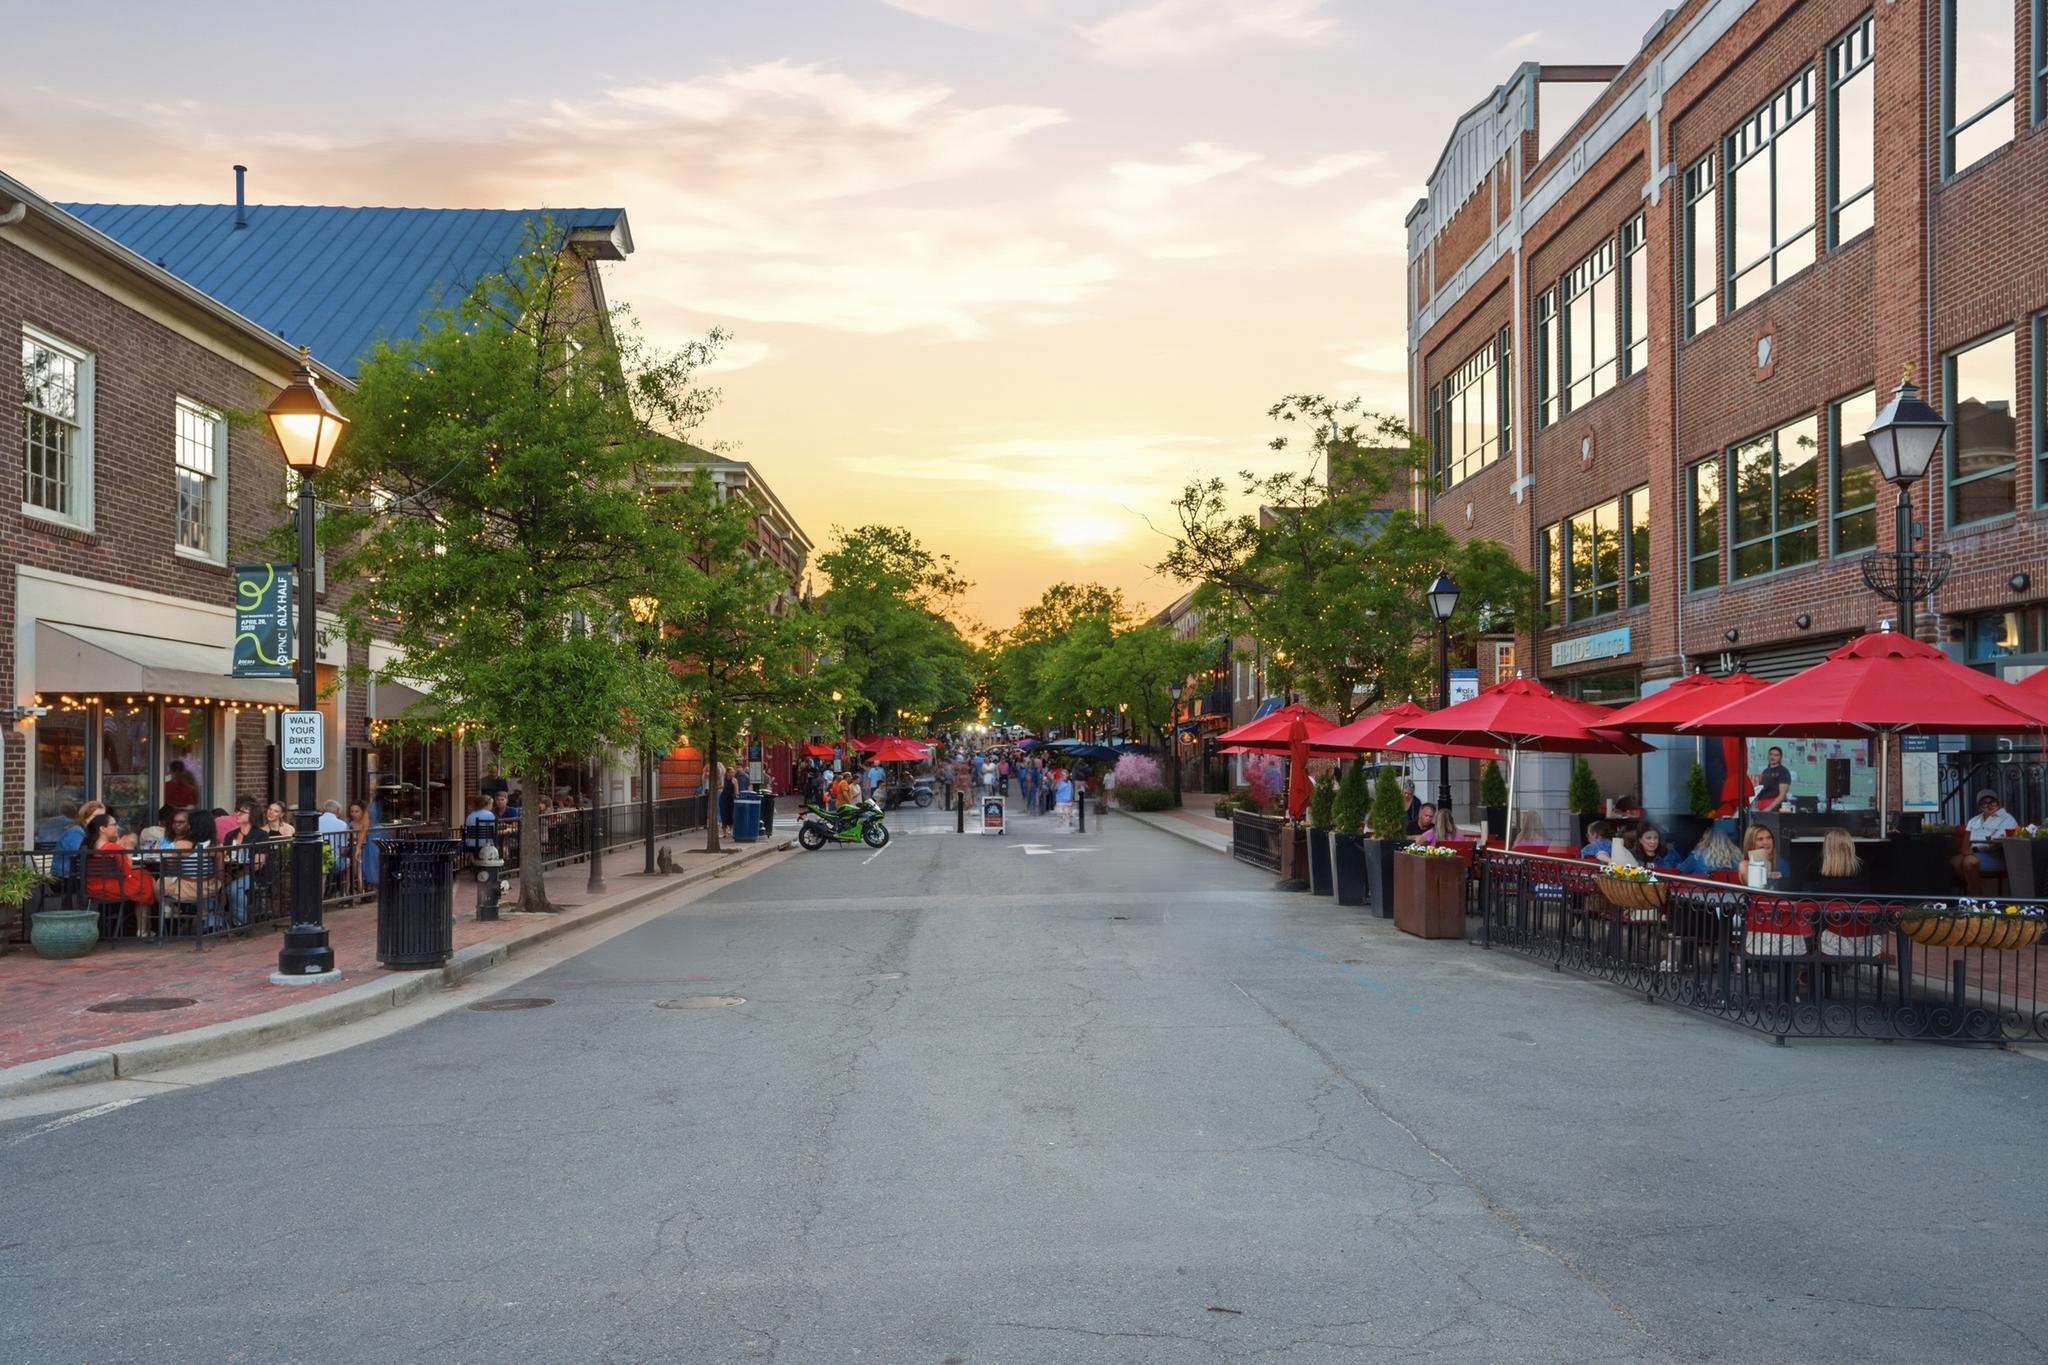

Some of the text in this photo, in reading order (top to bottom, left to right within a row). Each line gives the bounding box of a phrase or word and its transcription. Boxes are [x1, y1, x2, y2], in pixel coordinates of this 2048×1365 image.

[277, 576, 288, 603] HALF
[277, 632, 288, 654] PNC
[289, 716, 315, 724] WALK
[290, 726, 315, 734] YOUR
[289, 736, 315, 745] BIKES
[293, 746, 312, 755] AND
[286, 757, 320, 765] SCOOTERS
